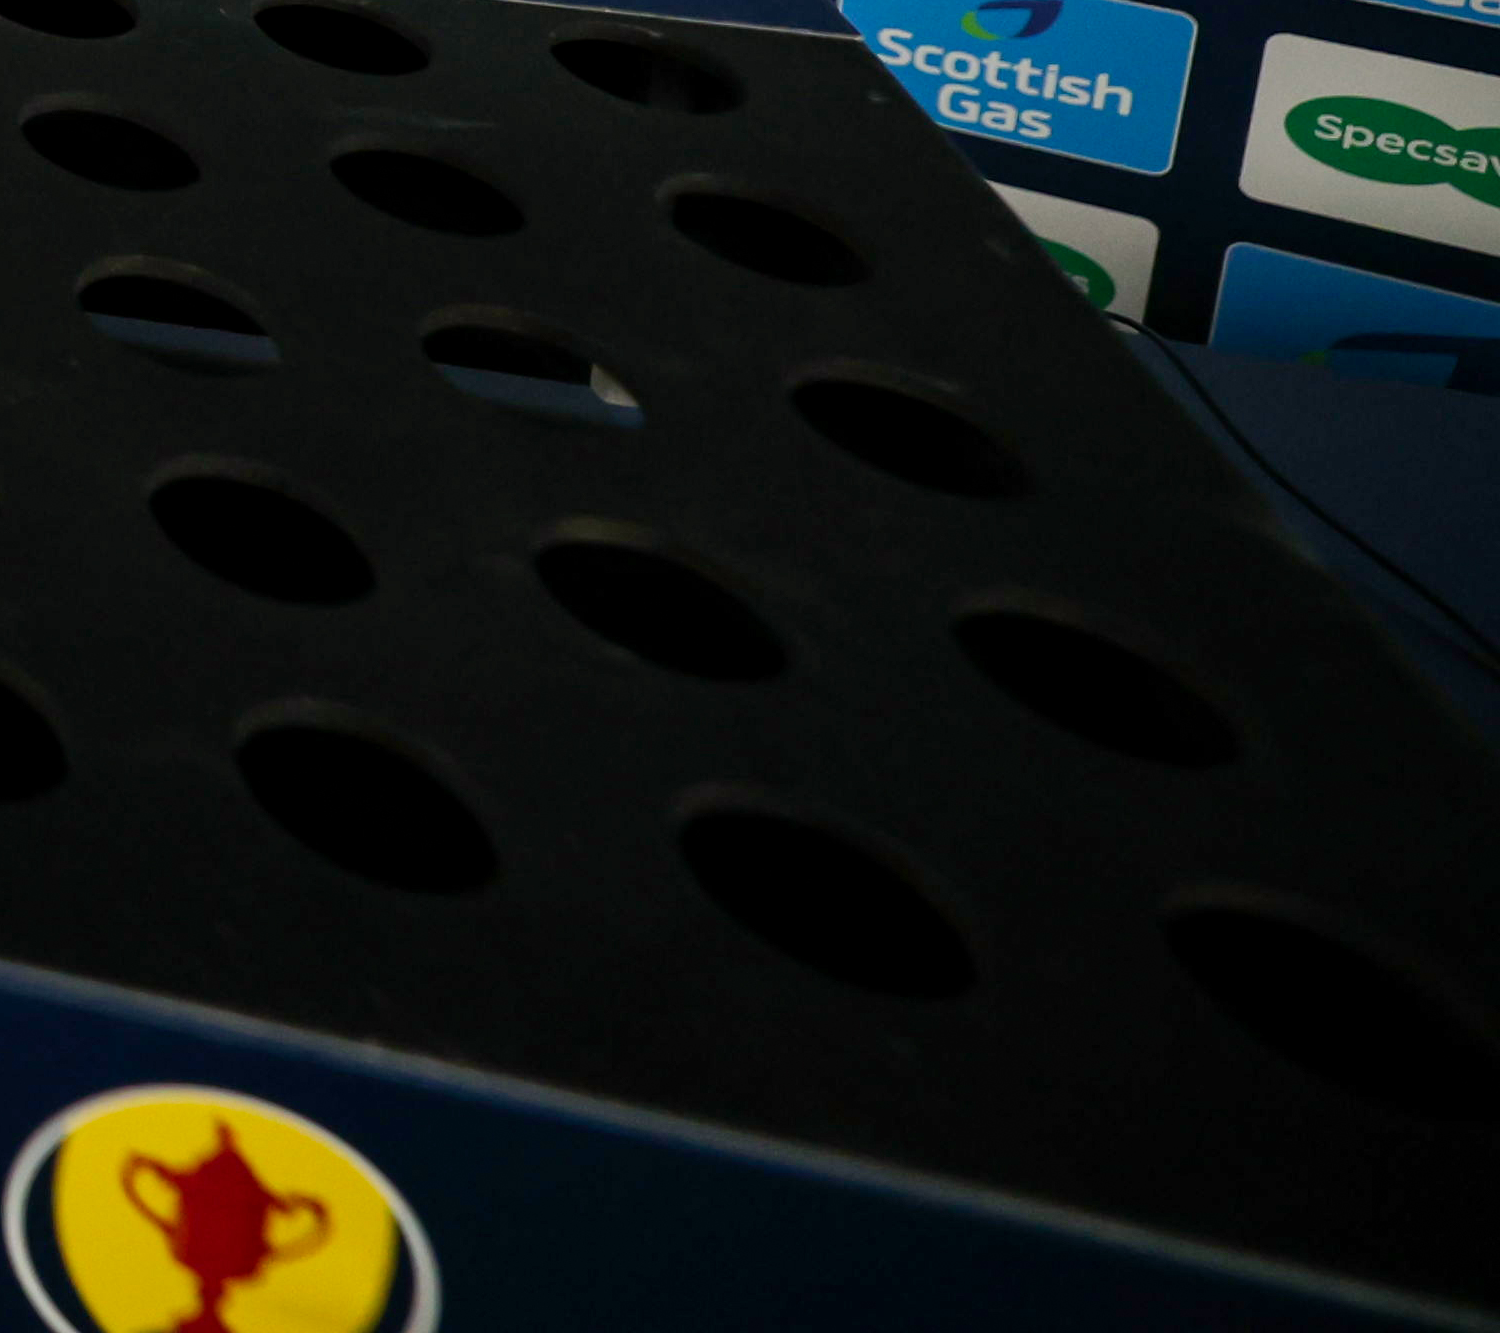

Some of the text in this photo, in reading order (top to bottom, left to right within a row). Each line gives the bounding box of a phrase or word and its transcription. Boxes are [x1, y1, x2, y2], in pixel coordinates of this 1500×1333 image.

[876, 27, 1133, 118] Scottish
[937, 85, 1053, 140] Gas
[1314, 113, 1500, 175] Specsa
